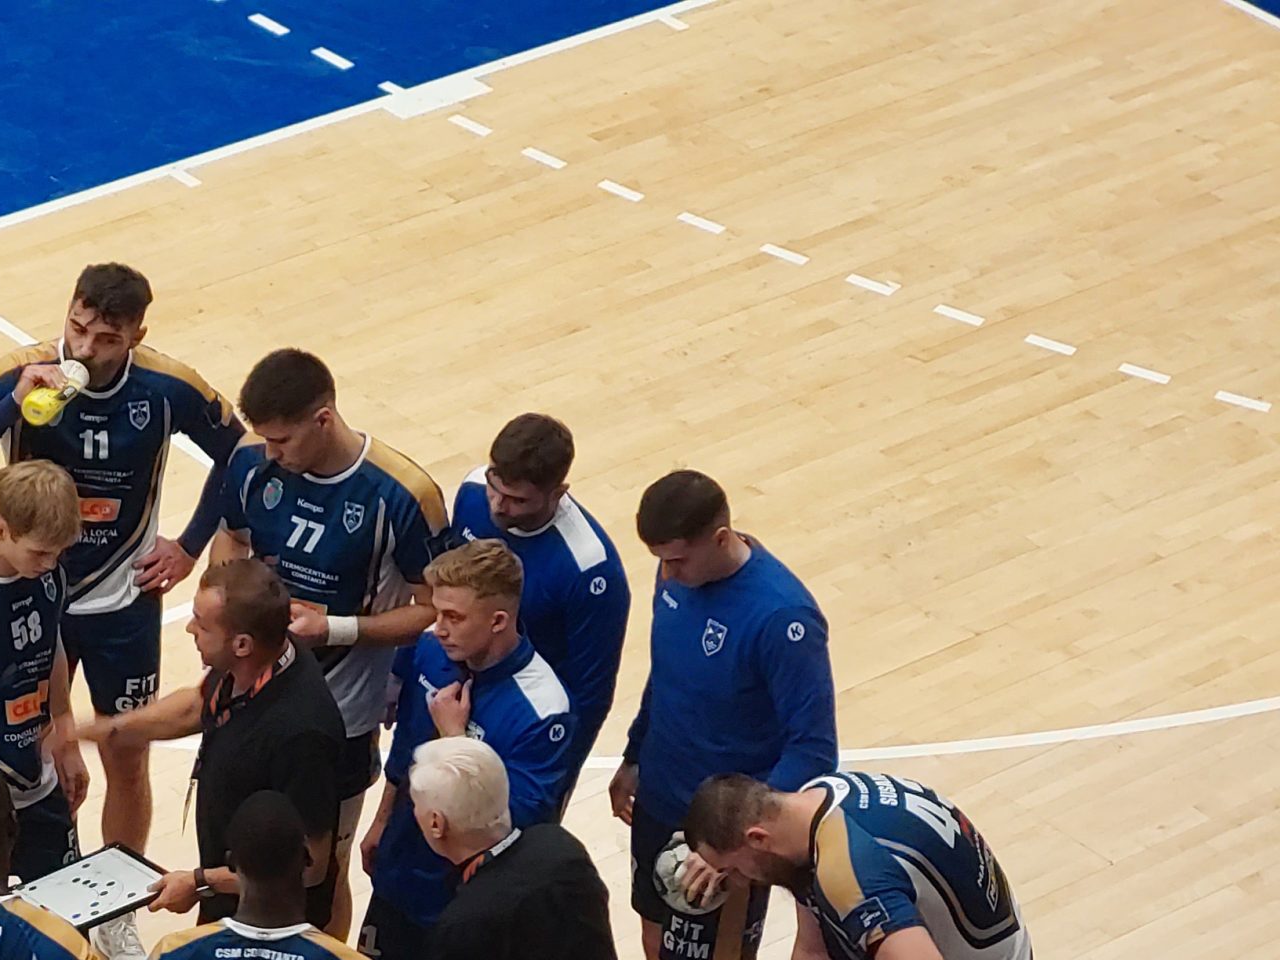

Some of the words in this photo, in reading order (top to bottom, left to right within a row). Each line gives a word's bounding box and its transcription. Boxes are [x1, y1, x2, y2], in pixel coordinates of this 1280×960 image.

[79, 429, 109, 459] 11
[286, 515, 326, 553] 77
[11, 610, 42, 650] 58
